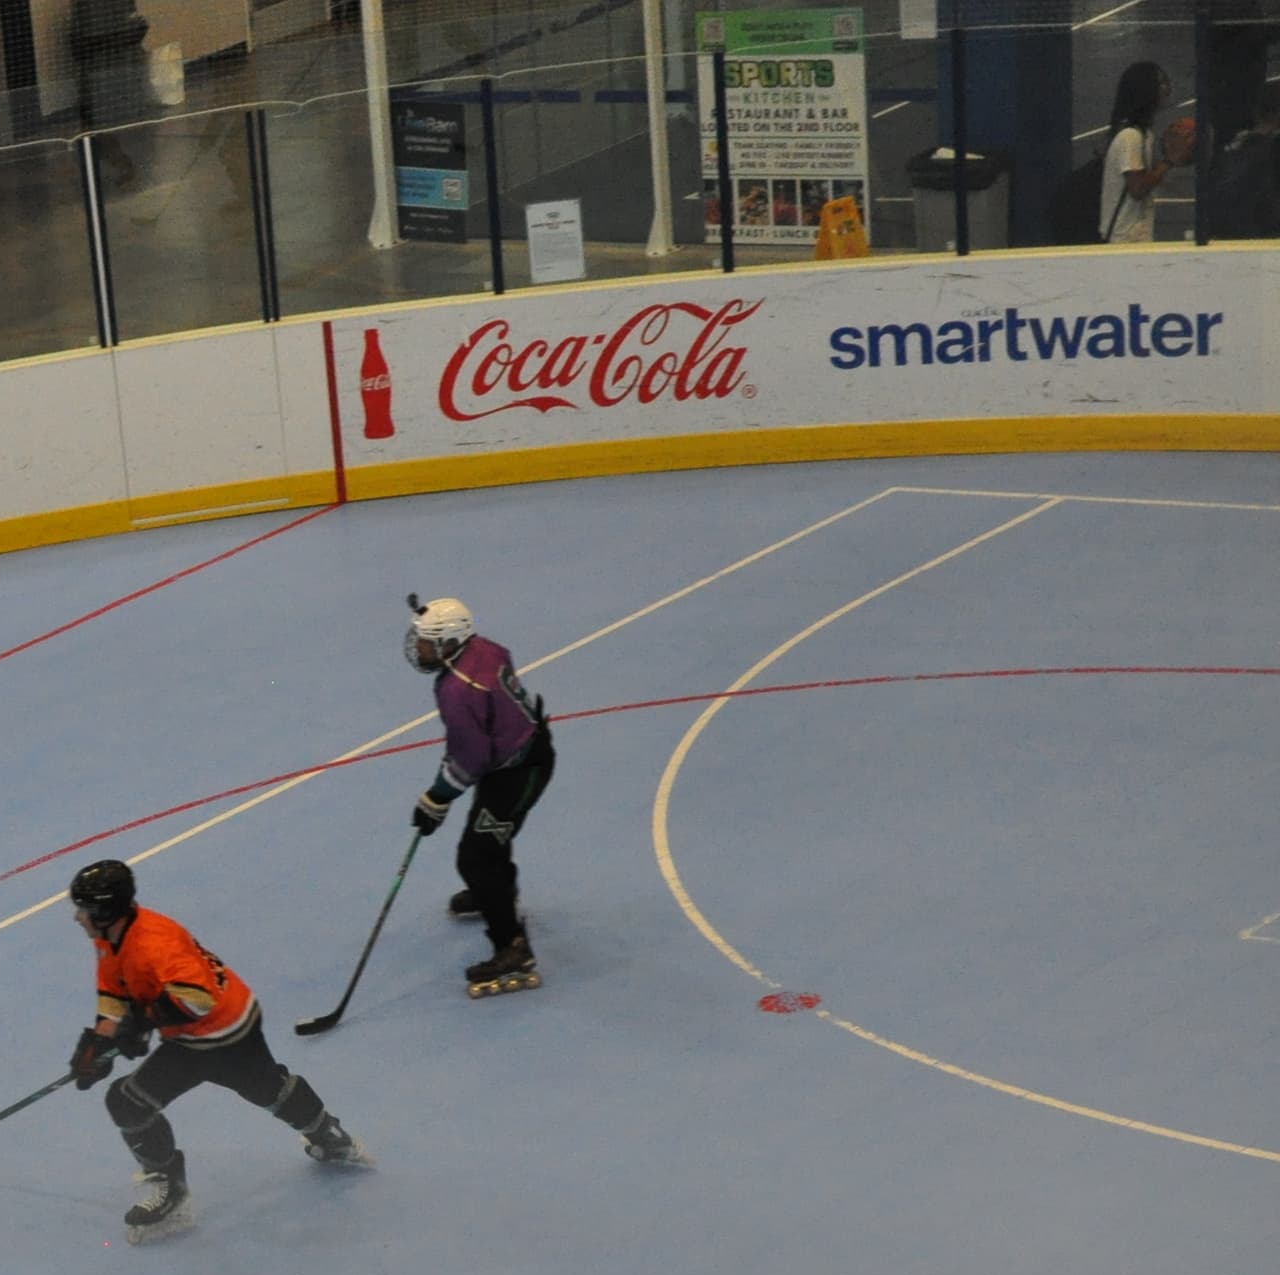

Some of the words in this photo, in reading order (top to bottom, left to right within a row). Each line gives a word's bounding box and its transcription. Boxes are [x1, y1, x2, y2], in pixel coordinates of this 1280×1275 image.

[724, 59, 835, 88] SPORTS
[743, 91, 816, 104] KITCHEN
[711, 108, 801, 119] RSTAURANT
[821, 108, 848, 119] BAR
[753, 122, 770, 132] ON
[774, 122, 792, 132] THE
[823, 122, 860, 132] FLOOR
[829, 303, 1223, 370] smartwater
[439, 296, 766, 422] Coca-Cola
